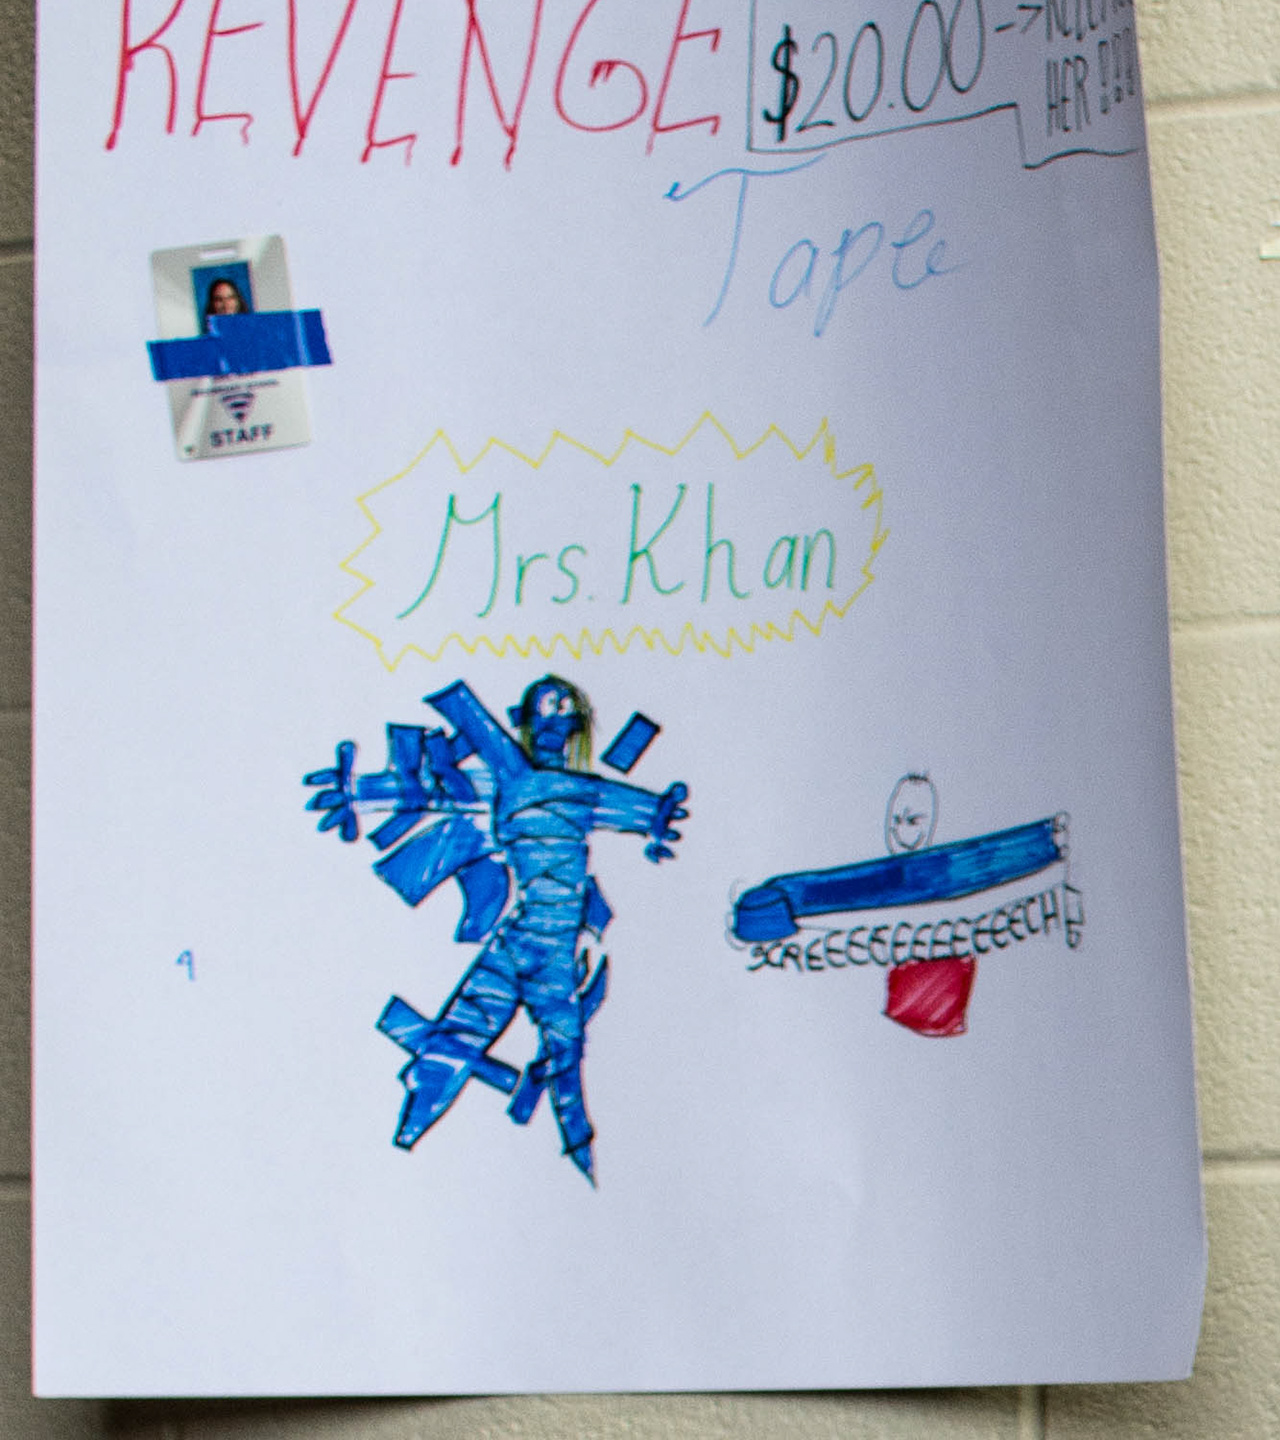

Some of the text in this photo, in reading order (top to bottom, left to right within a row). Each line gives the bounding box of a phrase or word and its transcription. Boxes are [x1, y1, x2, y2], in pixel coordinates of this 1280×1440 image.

[1046, 54, 1091, 137] HER
[664, 152, 970, 338] Tape
[210, 422, 272, 448] STAFF
[396, 482, 838, 619] Mrs. Khan
